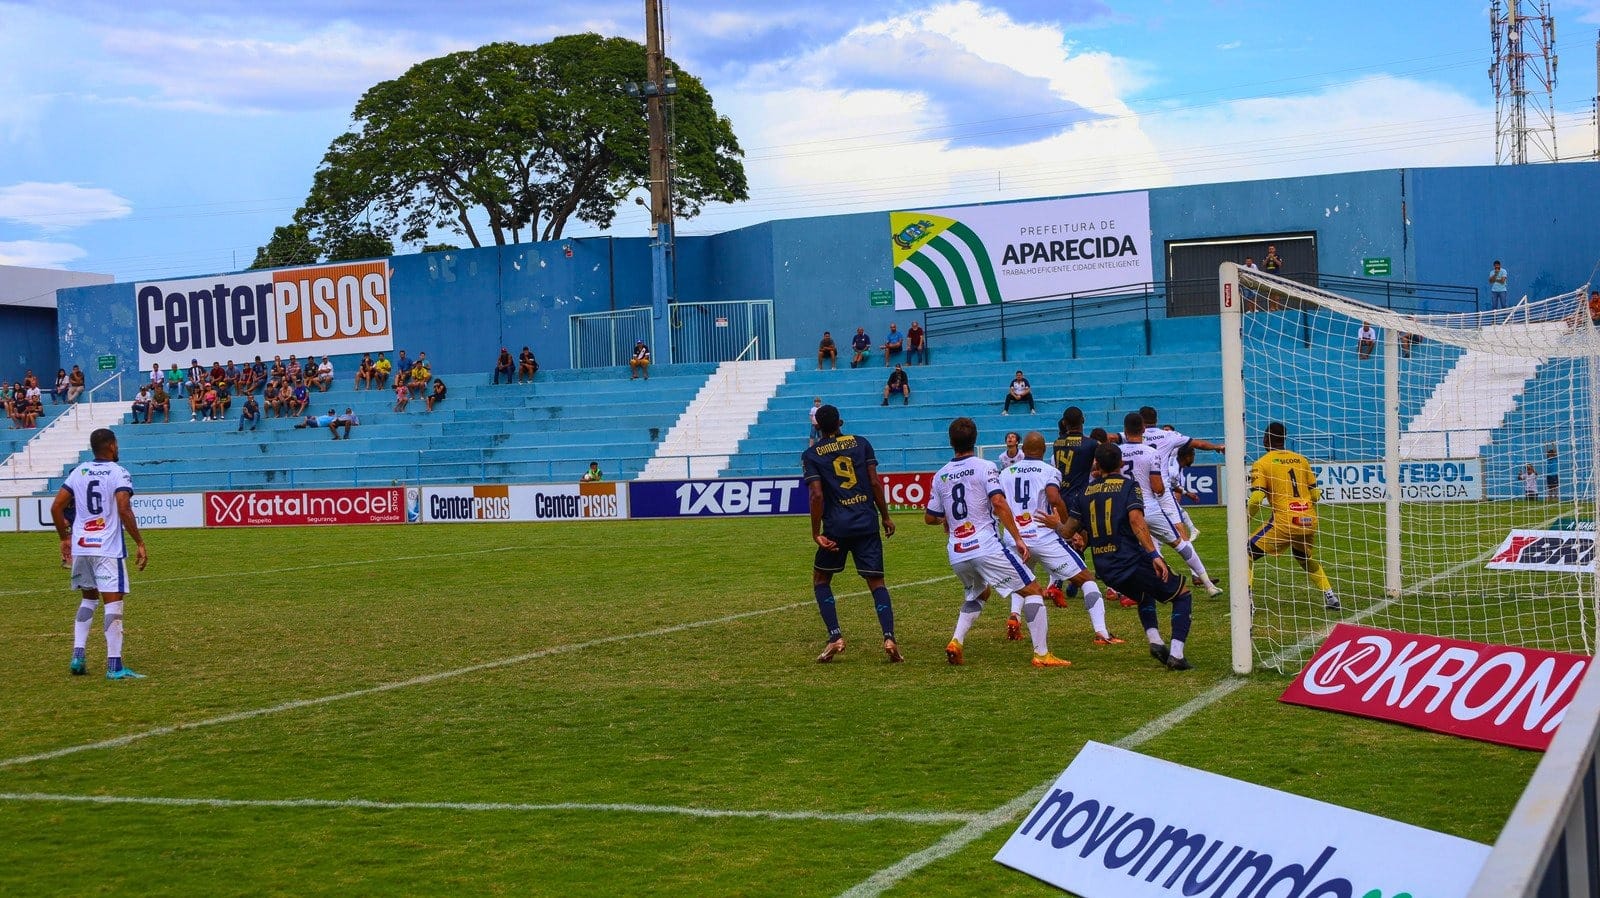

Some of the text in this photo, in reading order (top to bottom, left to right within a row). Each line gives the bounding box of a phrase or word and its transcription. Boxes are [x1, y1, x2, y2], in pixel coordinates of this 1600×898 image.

[1020, 219, 1116, 236] PREFEITURA DE
[1001, 234, 1138, 266] APARECIDA
[1001, 266, 1037, 277] TRABALHO
[1072, 261, 1097, 272] CIDADE
[1097, 259, 1141, 270] INTELIGENTE
[137, 272, 388, 355] CenterPISOS
[832, 455, 858, 490] 9
[948, 468, 975, 481] SICOOB
[1017, 466, 1042, 475] SICOOB
[1287, 467, 1300, 498] 1
[1327, 465, 1360, 486] NO
[86, 480, 104, 515] 6
[132, 496, 185, 510] erviço que
[248, 490, 392, 516] fatalmodel
[675, 479, 800, 515] 1XBET
[951, 482, 968, 521] 8
[1014, 477, 1031, 510] 4
[1399, 484, 1468, 499] TORCIDA
[369, 514, 400, 522] Dignidade
[430, 494, 510, 520] CenterPISOS
[535, 492, 617, 519] CenterPISOS
[1089, 497, 1113, 538] 11
[1361, 640, 1586, 733] KRON
